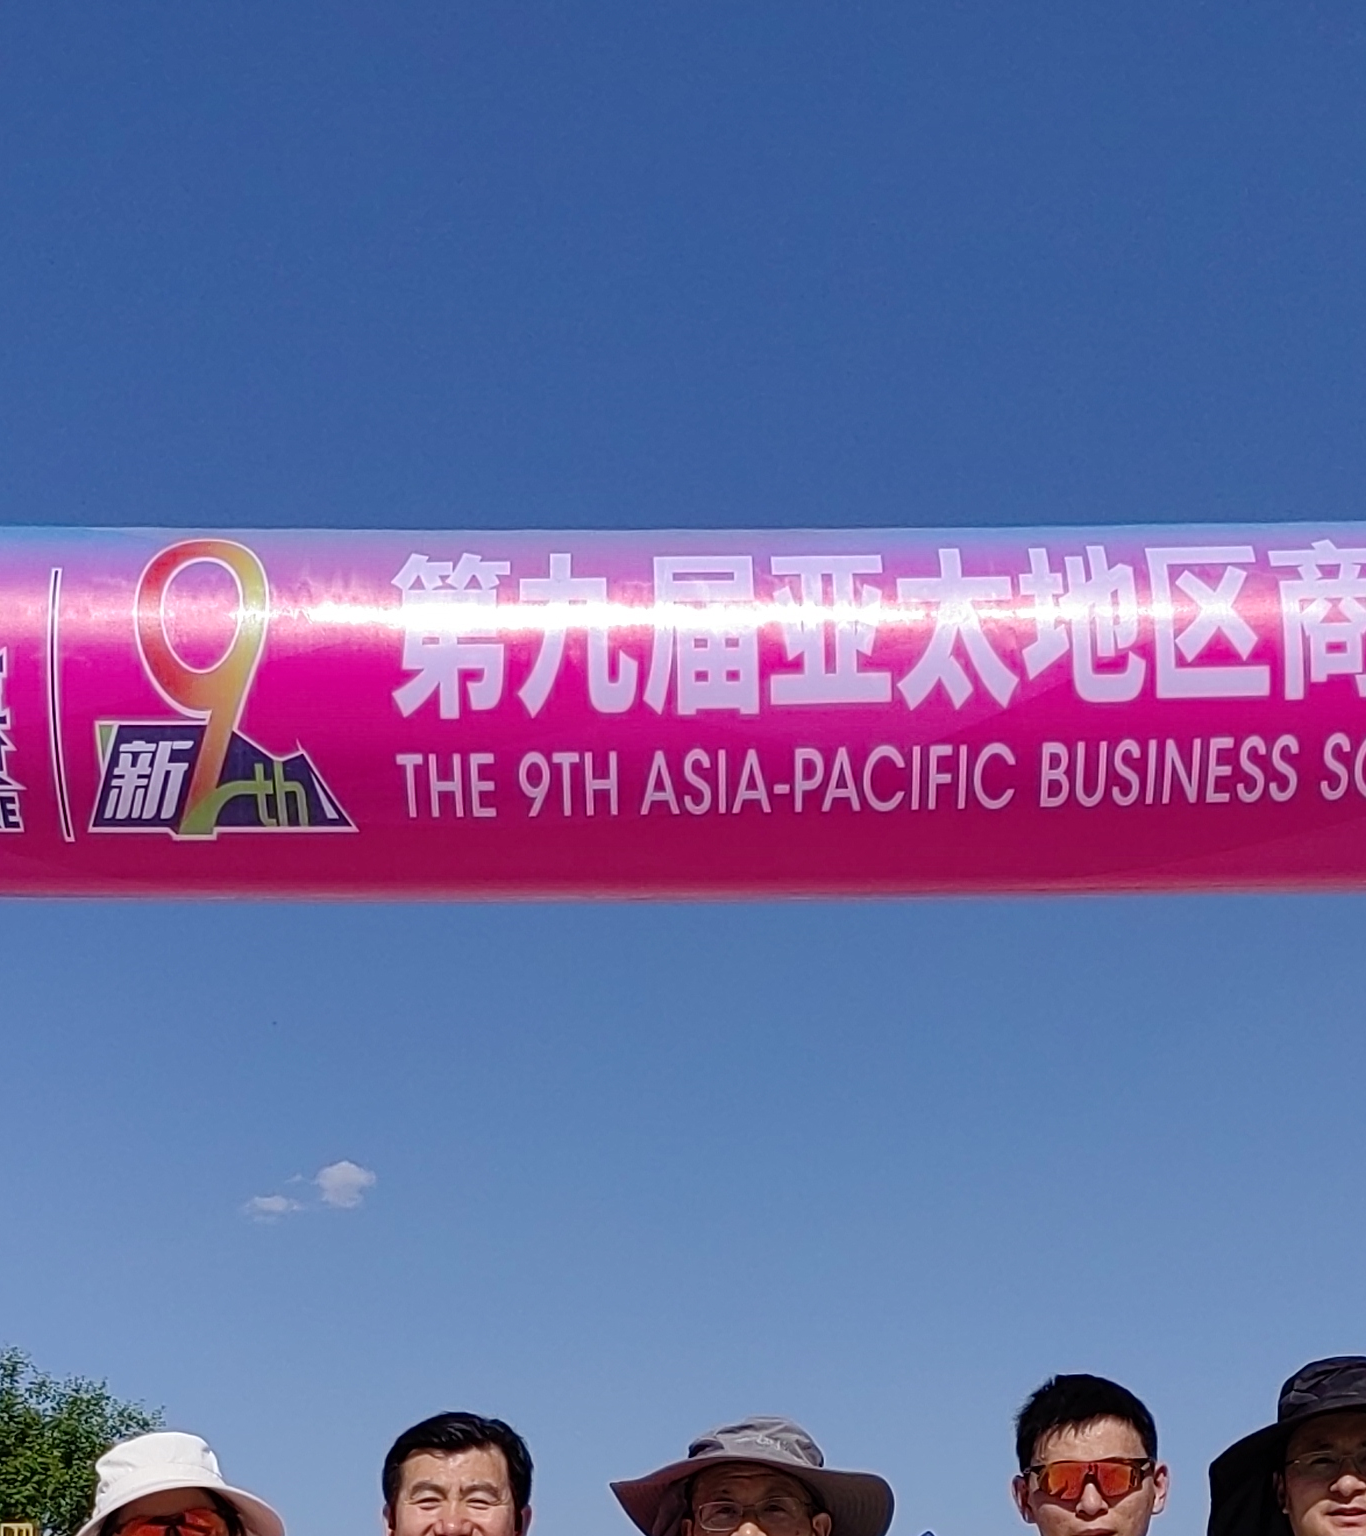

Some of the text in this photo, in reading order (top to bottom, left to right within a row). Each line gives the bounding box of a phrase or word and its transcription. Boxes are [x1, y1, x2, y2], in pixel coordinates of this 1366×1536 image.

[396, 752, 496, 819] THE
[519, 750, 619, 818] 9TH
[641, 742, 1016, 816] ASIA-PACIFIC
[1040, 733, 1299, 809] BUSINESS
